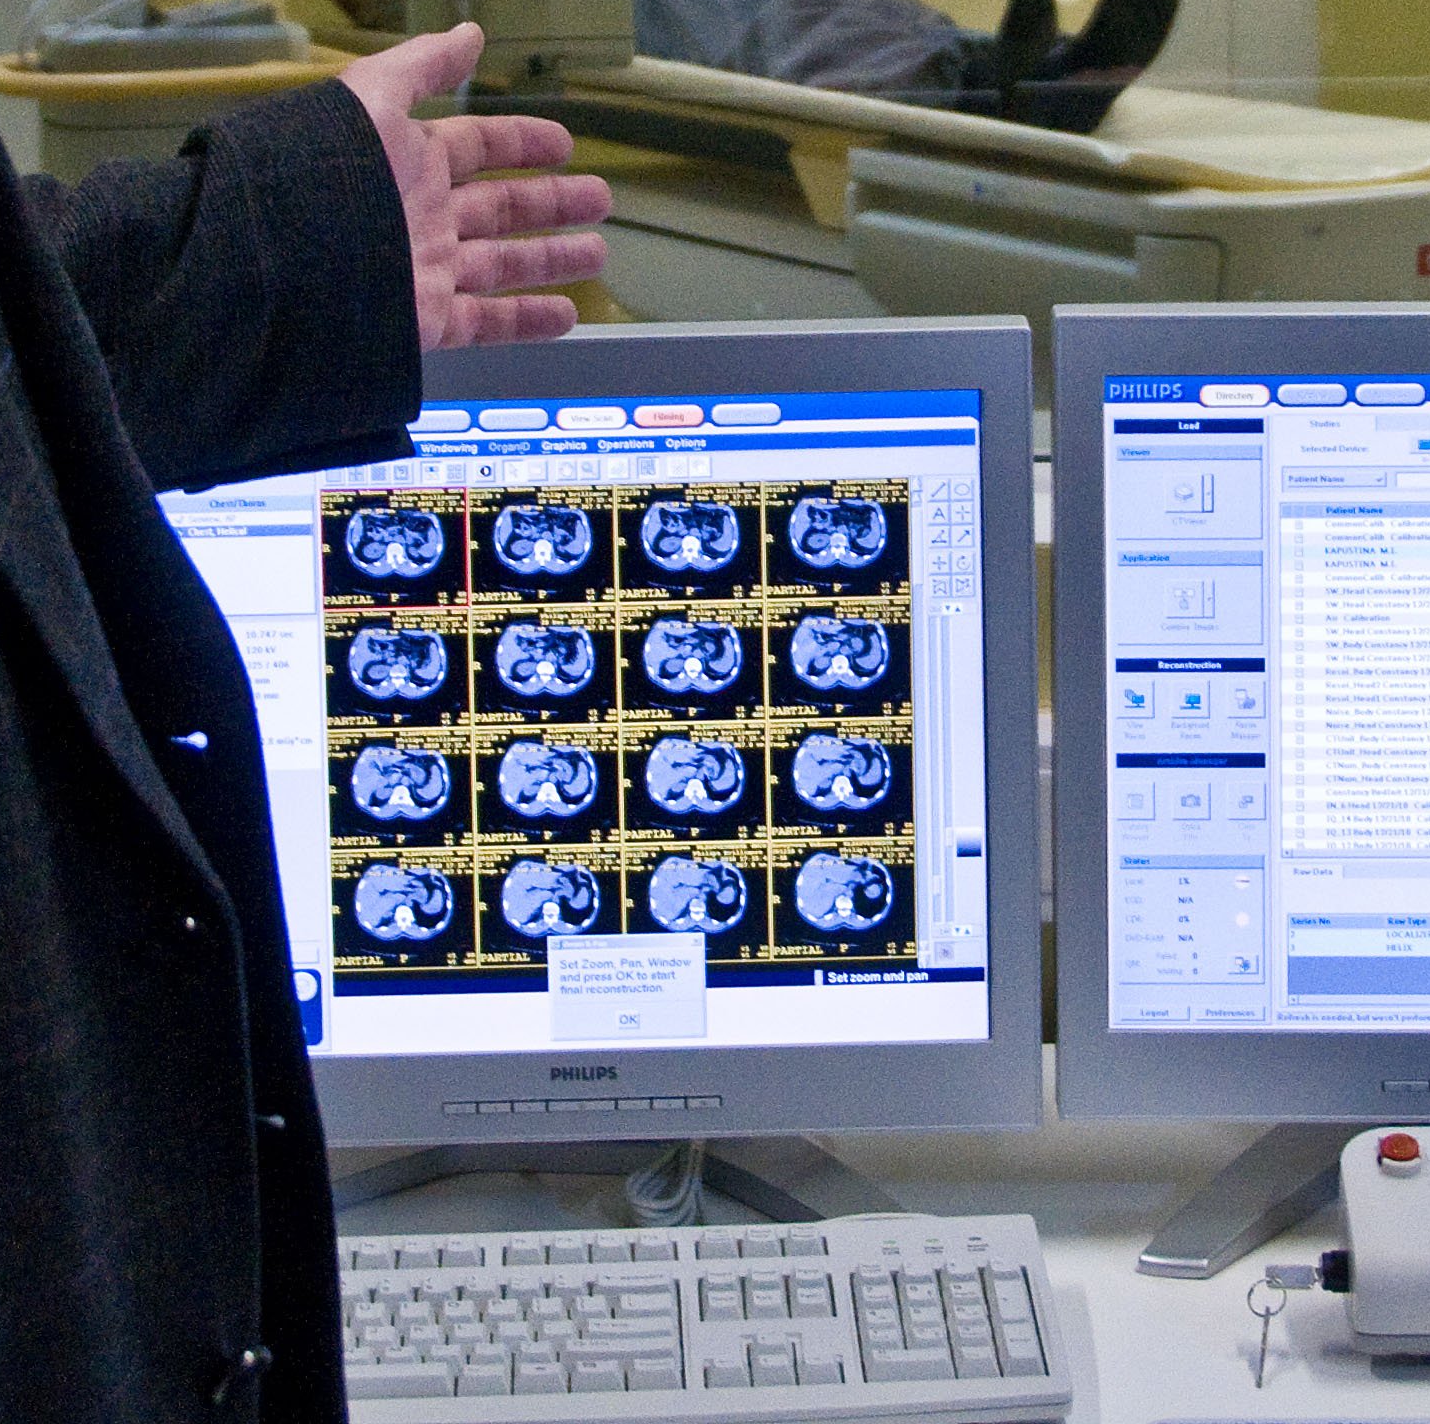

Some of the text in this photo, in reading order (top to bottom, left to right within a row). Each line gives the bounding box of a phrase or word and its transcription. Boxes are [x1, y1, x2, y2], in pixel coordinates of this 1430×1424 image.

[1109, 383, 1183, 399] PHILIPS
[1214, 390, 1255, 402] Directory
[1177, 421, 1200, 431] Load
[420, 442, 479, 455] Windowing
[541, 439, 588, 452] Graphics
[597, 438, 655, 452] Operations
[665, 437, 707, 450] Options
[1325, 506, 1384, 515] Patient Name
[1121, 554, 1171, 564] Application
[619, 588, 670, 599] PARTIAL
[767, 585, 818, 596] PARTIAL
[324, 595, 375, 606] PARTIAL
[471, 591, 522, 602] PARTIAL
[1157, 660, 1223, 671] Reconstruction
[622, 709, 673, 720] PARTIAL
[769, 705, 820, 716] PARTIAL
[327, 715, 378, 726] PARTIAL
[474, 712, 525, 723] PARTIAL
[624, 829, 675, 840] PARTIAL
[771, 825, 822, 836] PARTIAL
[330, 836, 381, 847] PARTIAL
[477, 832, 528, 843] PARTIAL
[773, 945, 824, 956] PARTIAL
[333, 955, 384, 966] PARTIAL
[480, 952, 531, 963] PARTIAL
[559, 958, 580, 970] Set
[647, 956, 692, 969] Window
[559, 969, 677, 985] and press OK to start
[827, 970, 929, 985] Set zoom and pan
[559, 984, 584, 996] final
[618, 1014, 639, 1026] OK
[549, 1065, 619, 1082] PHILIPS
